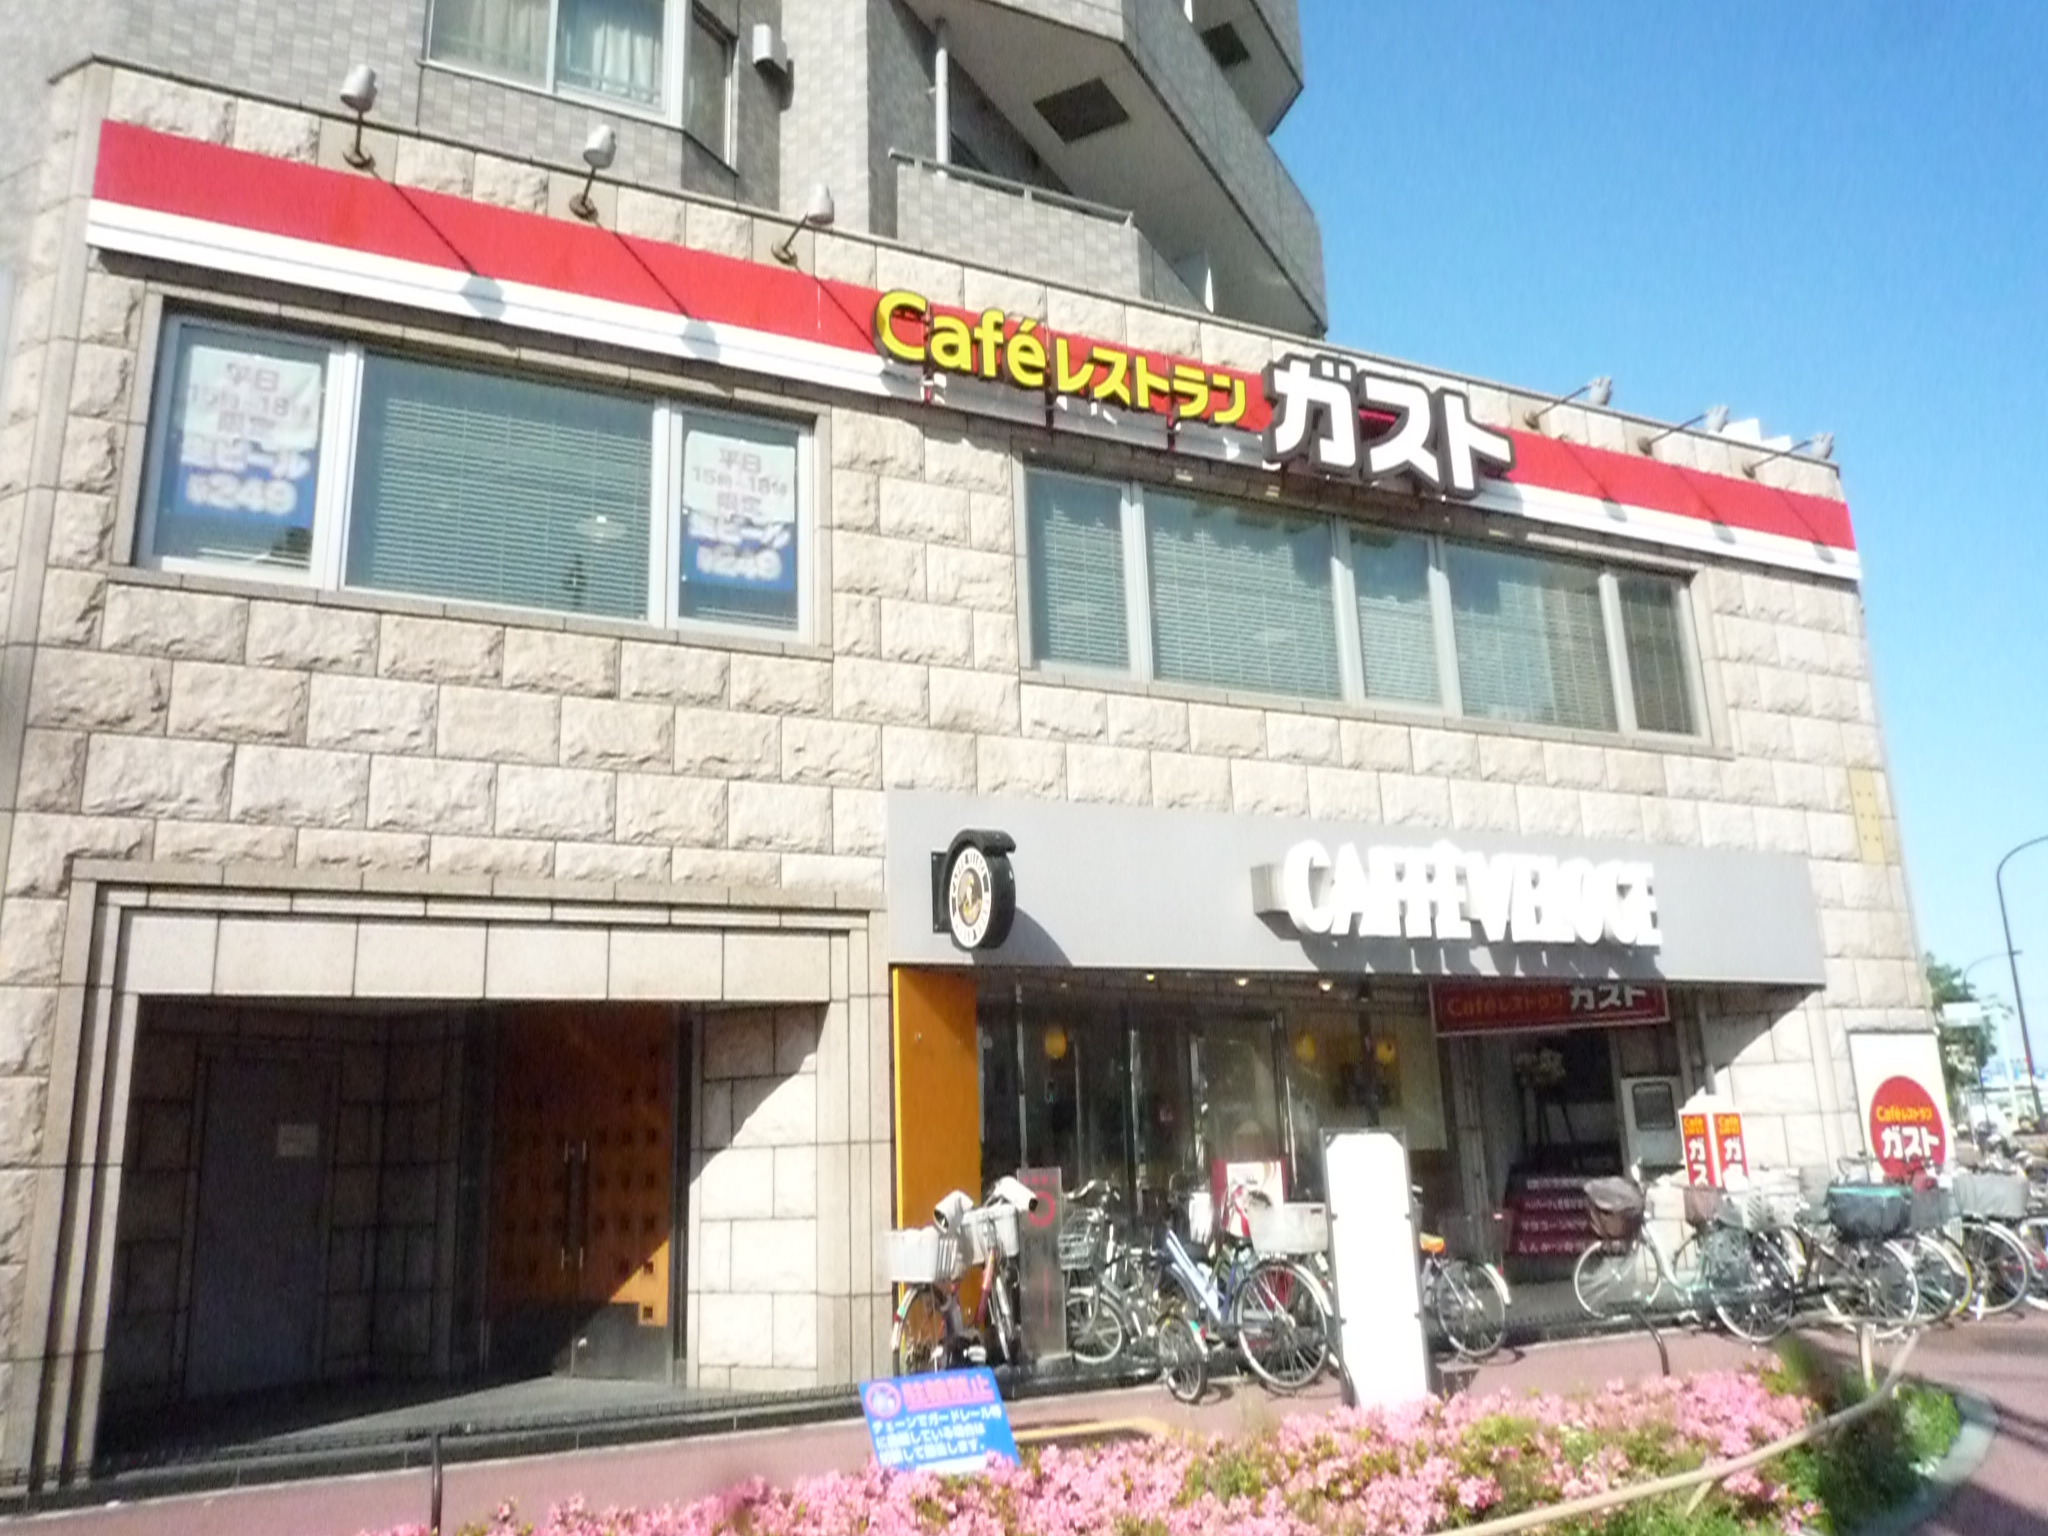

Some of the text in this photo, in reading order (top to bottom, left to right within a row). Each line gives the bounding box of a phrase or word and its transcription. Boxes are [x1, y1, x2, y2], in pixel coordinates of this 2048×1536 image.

[1270, 356, 1513, 496] ガスト
[719, 448, 762, 474] 平日
[1464, 850, 1663, 946] VELOCE
[1881, 1124, 1940, 1160] ガスト
